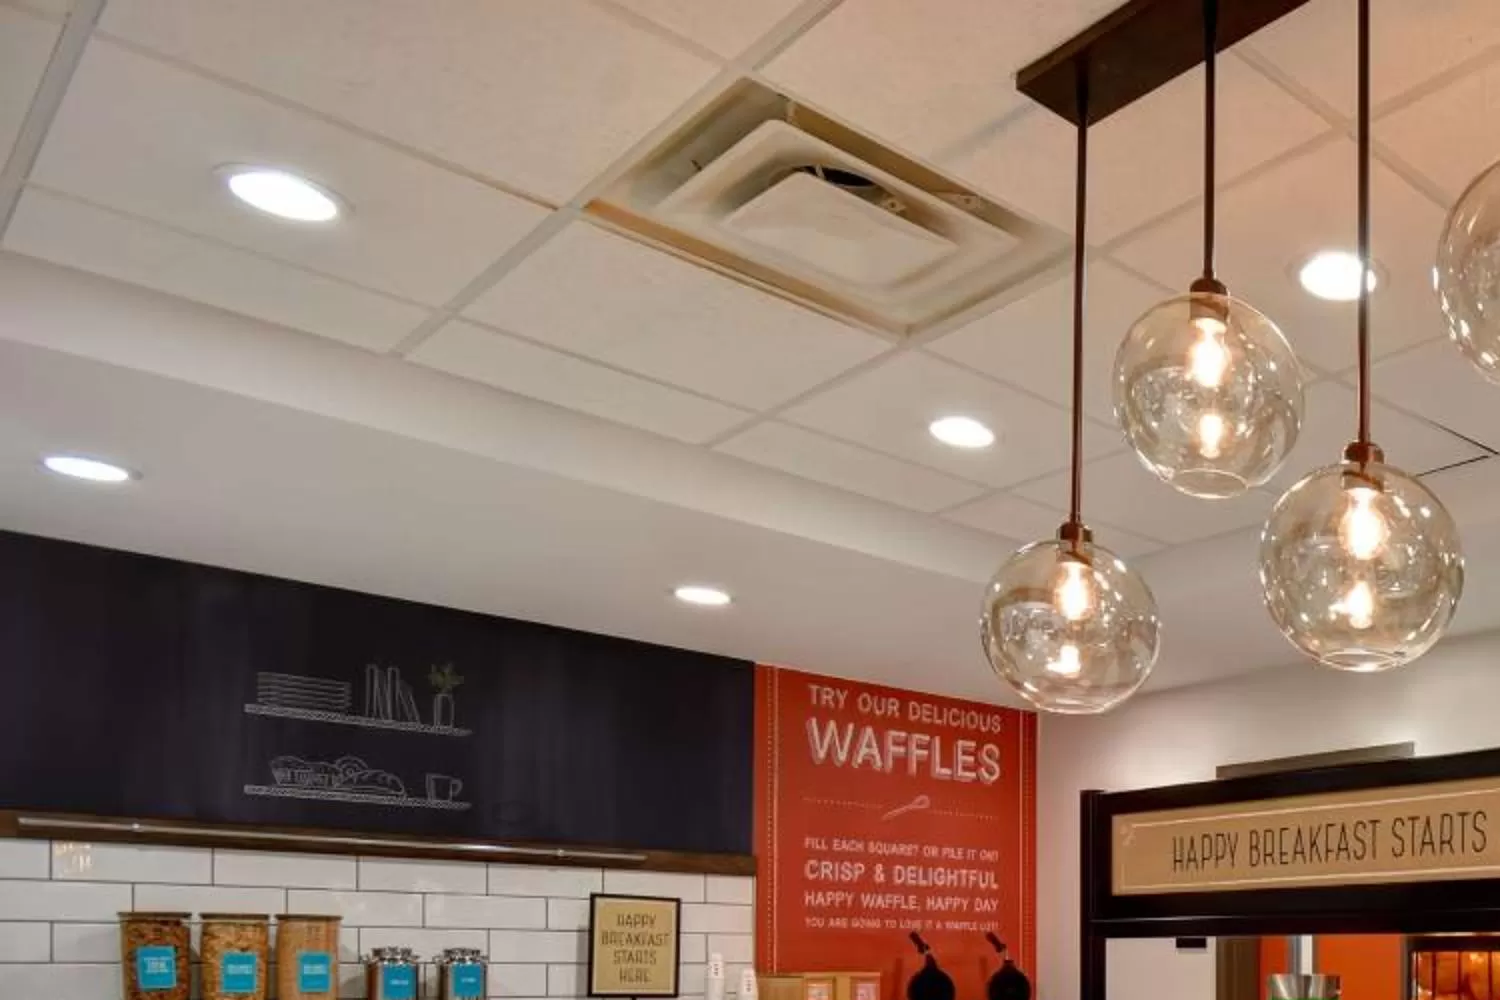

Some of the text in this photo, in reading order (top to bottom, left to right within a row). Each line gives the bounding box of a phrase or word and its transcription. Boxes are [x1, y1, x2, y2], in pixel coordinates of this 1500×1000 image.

[808, 684, 1001, 734] TRY OUR DELICIOUS
[806, 716, 1001, 784] WAFFLES
[804, 837, 828, 850] FILL
[833, 839, 864, 852] EACH
[867, 840, 919, 857] SQUARE?
[923, 845, 939, 857] OR
[941, 846, 964, 860] PILE
[966, 848, 977, 861] IT
[1172, 832, 1239, 873] HAPPY
[1248, 818, 1382, 866] BREAKFAST
[1390, 810, 1489, 858] STARTS
[804, 858, 999, 890] CRISP & DELIGHTFUL
[804, 891, 999, 913] HAPPY WAFFLE, HAPPY DAY
[617, 913, 656, 928] HAPPY
[805, 917, 825, 929] YOU
[828, 918, 847, 929] ARE
[884, 919, 897, 929] TO
[601, 931, 670, 946] BREAKFAST
[613, 949, 656, 965] STARTS
[620, 967, 652, 983] HERE
